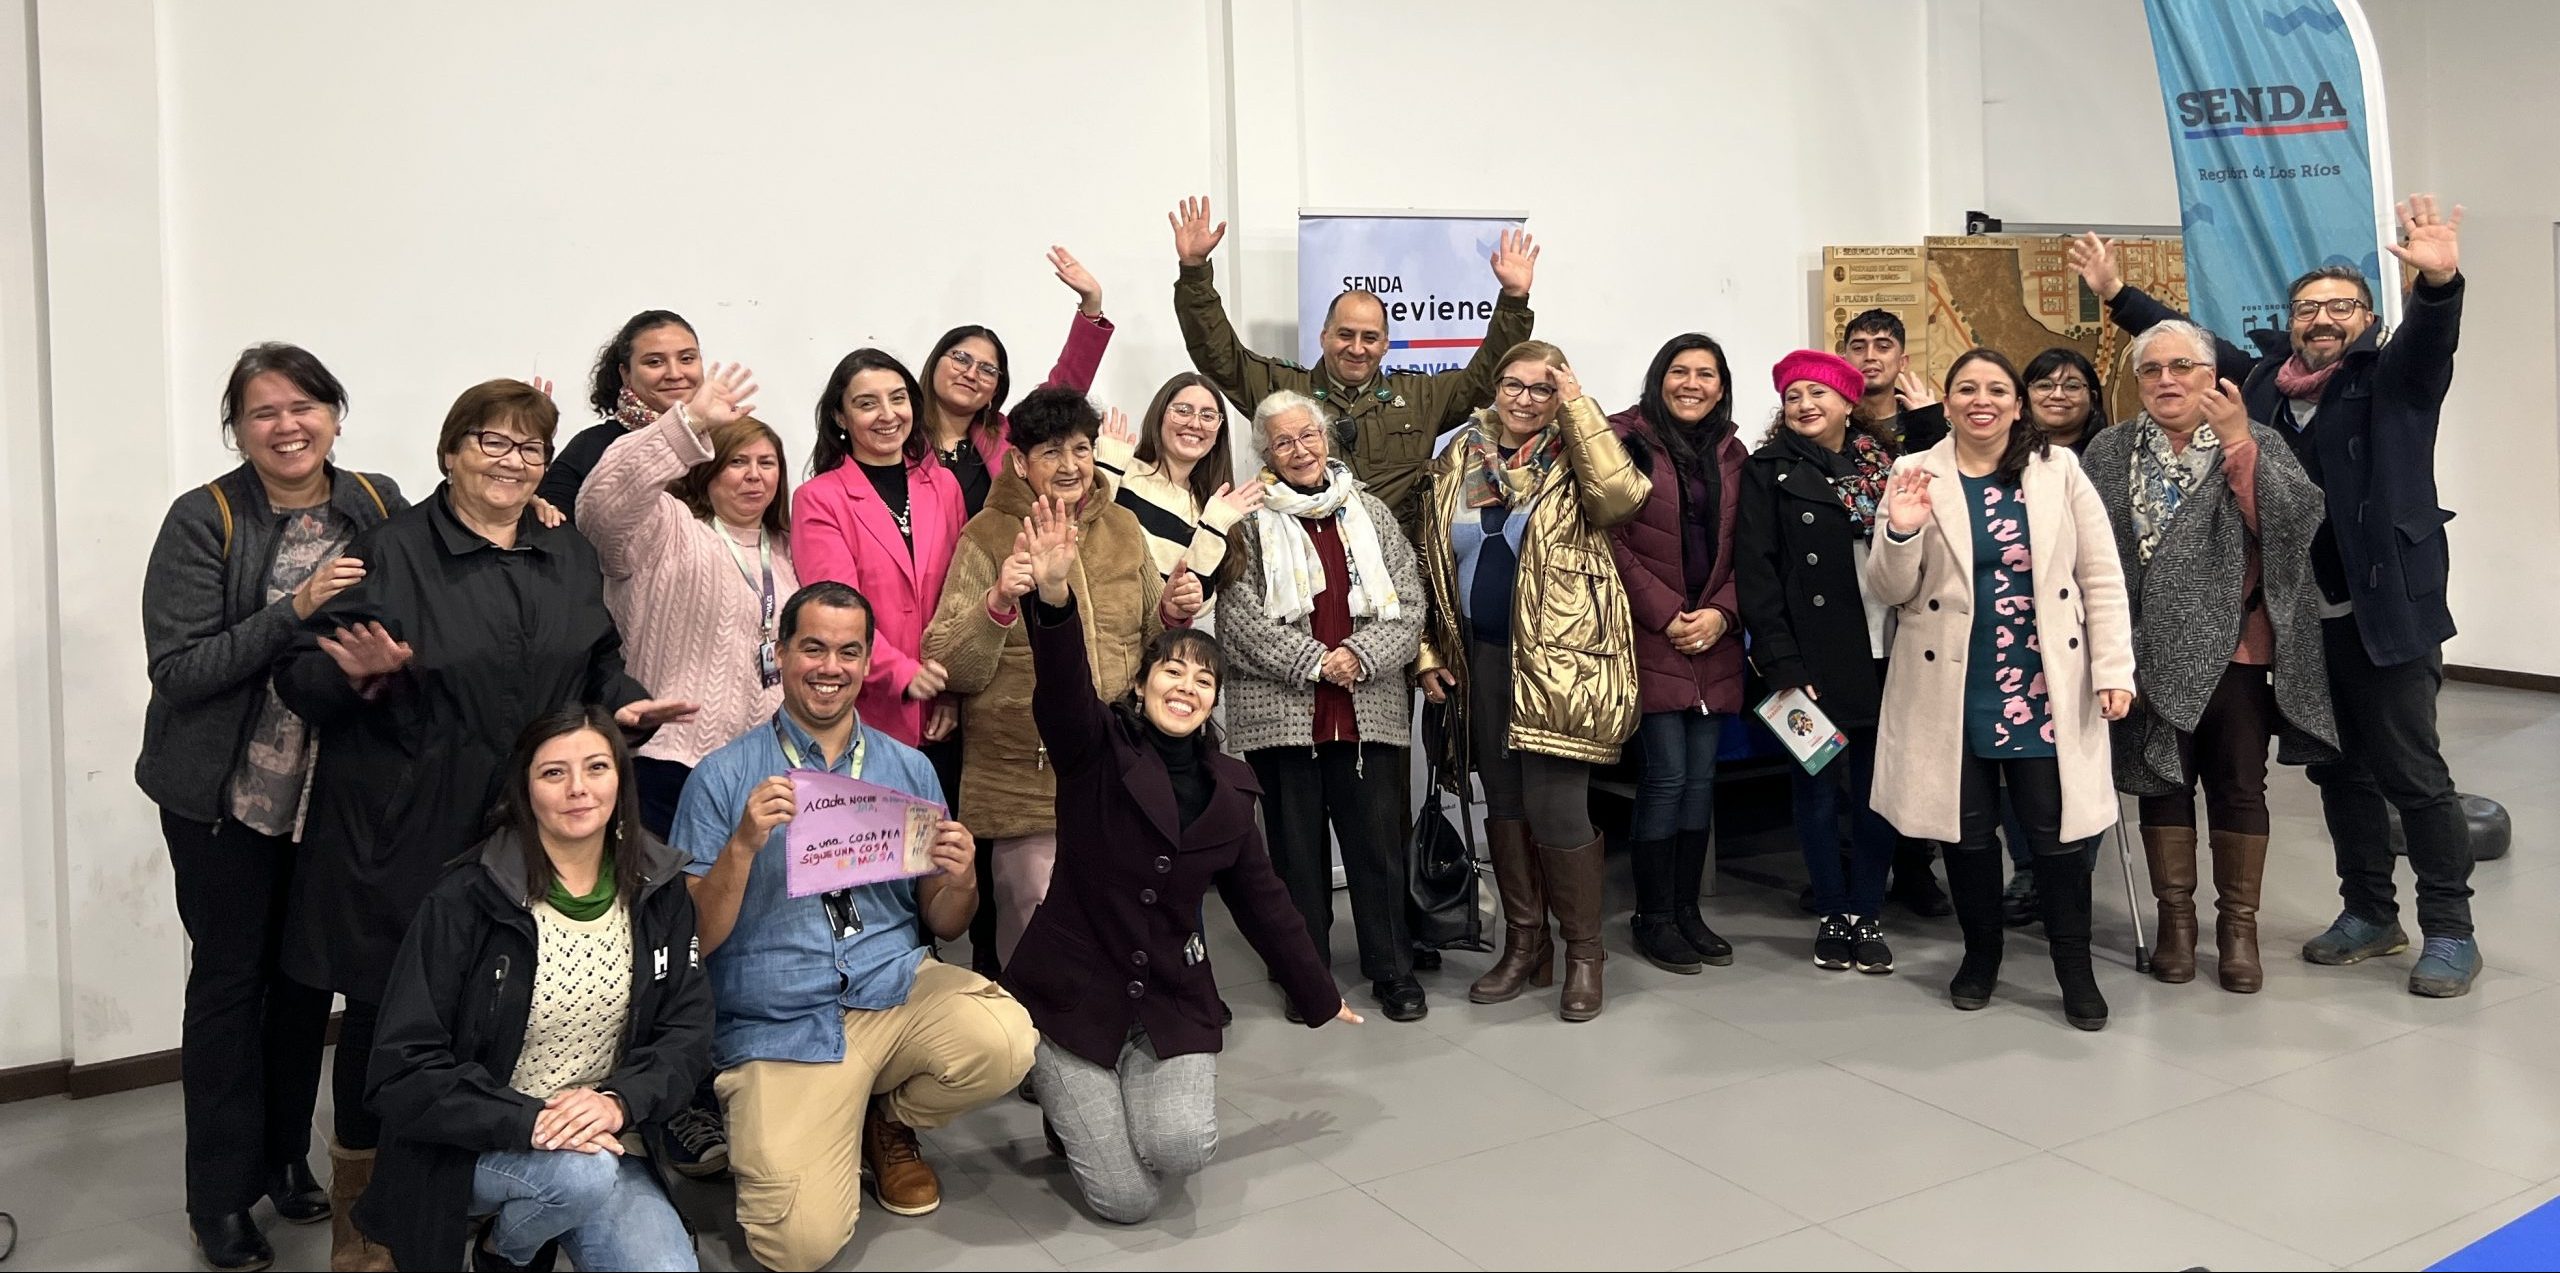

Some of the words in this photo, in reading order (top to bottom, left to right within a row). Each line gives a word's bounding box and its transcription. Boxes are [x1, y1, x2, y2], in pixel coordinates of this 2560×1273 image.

[2176, 81, 2347, 127] SENDA
[2198, 165, 2248, 183] Región
[2253, 165, 2265, 178] de
[2270, 166, 2297, 179] Los
[2301, 164, 2341, 178] Ríos
[1843, 247, 1880, 256] SEGURIDAD
[1886, 247, 1916, 256] CONTROL
[1343, 276, 1403, 293] SENDA
[849, 831, 877, 844] COSA
[859, 841, 889, 854] COSA
